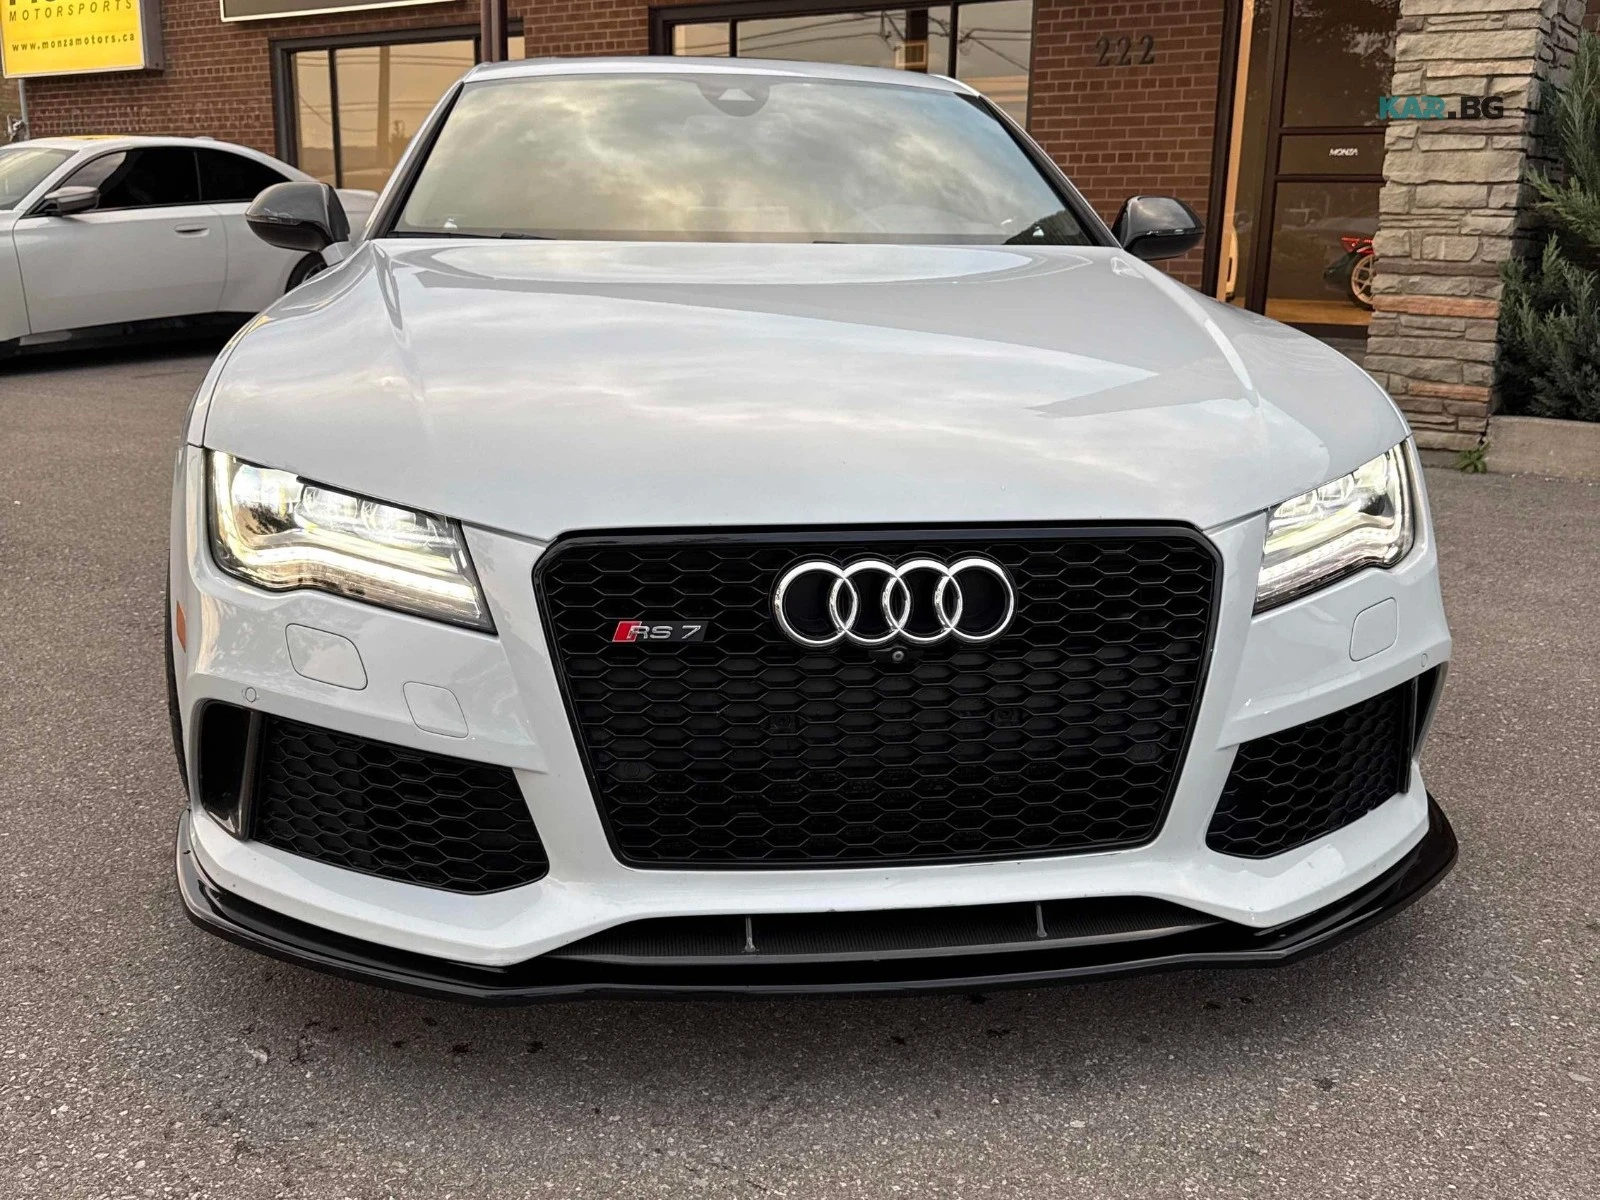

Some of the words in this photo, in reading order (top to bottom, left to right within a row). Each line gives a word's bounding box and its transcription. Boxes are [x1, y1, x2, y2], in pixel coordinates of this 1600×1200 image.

[9, 0, 132, 22] MOTORSPORTS
[12, 32, 135, 51] www.monzamotors.ca
[1096, 34, 1155, 67] 222
[682, 625, 701, 639] 7
